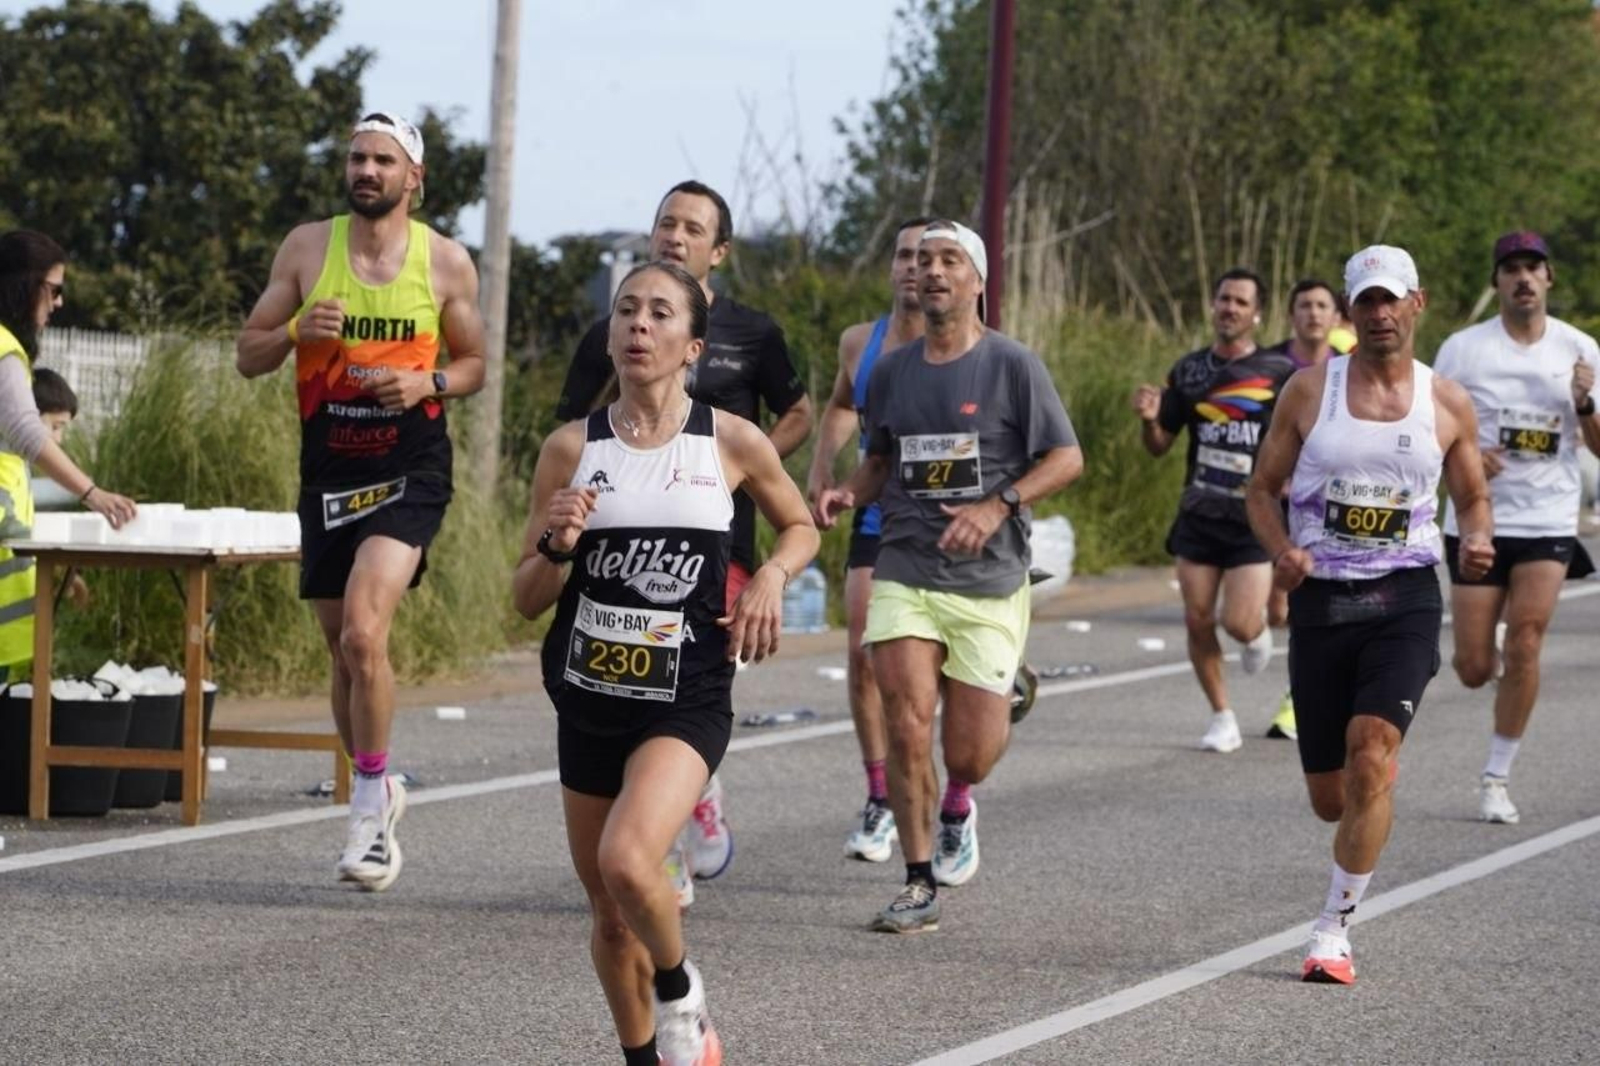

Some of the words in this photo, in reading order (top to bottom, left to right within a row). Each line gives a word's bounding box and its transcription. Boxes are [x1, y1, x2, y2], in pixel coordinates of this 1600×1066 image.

[342, 315, 415, 342] NORTH
[347, 365, 388, 378] Gasol
[1516, 430, 1550, 451] 430
[927, 461, 954, 484] 27
[347, 486, 390, 511] 442
[1346, 507, 1394, 532] 607
[586, 538, 705, 583] delikia
[645, 578, 678, 594] fresh
[589, 640, 651, 678] 230
